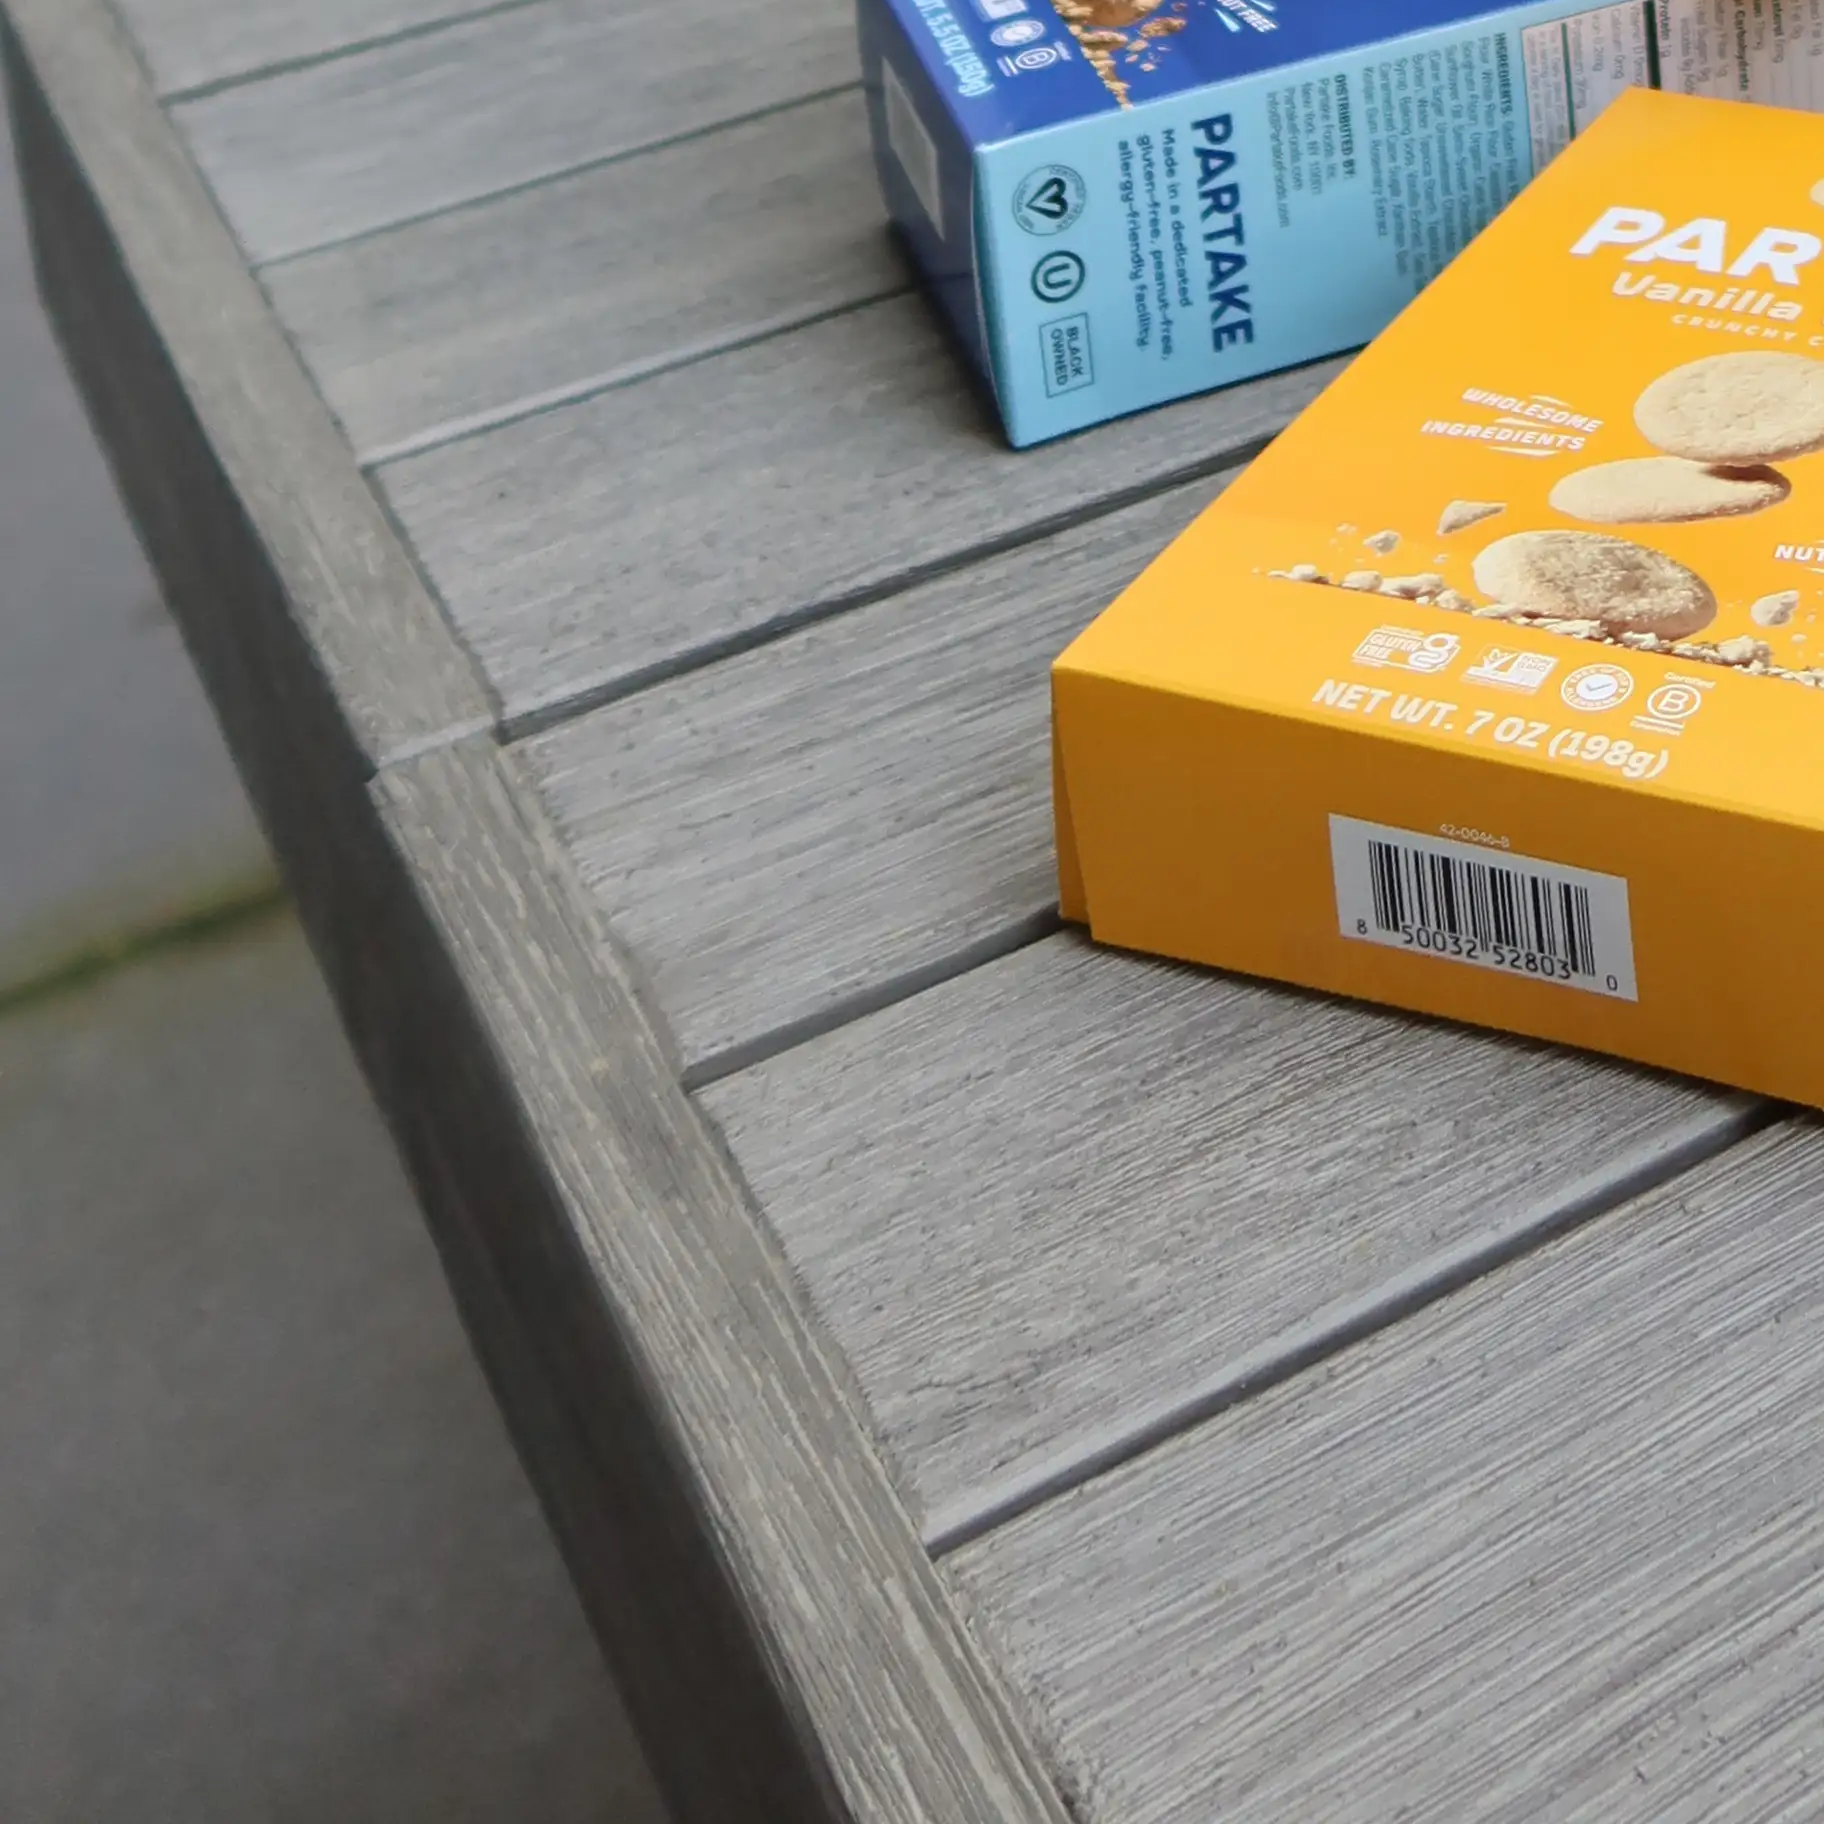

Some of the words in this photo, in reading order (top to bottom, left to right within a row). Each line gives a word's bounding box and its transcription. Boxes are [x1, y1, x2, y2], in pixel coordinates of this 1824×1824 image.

[1334, 74, 1353, 156] DISTRIBUTED
[1161, 128, 1179, 178] Made
[1118, 139, 1147, 282] allergy-friendly
[1165, 181, 1180, 200] in
[1170, 204, 1181, 215] a
[1136, 135, 1162, 250] gluten-free,
[1149, 250, 1175, 361] peanut-free,
[1189, 112, 1255, 354] PARTAKE
[1171, 218, 1195, 308] dedicated
[1610, 271, 1803, 323] Vanilla
[1066, 325, 1084, 378] BLACK
[1670, 314, 1798, 344] CRUNCHY
[1050, 328, 1069, 387] OWNED
[1419, 419, 1587, 452] INGREDIENTS
[1461, 386, 1605, 434] WHOLESOME
[1312, 678, 1393, 714] NET
[1390, 694, 1460, 730] WT.
[1465, 709, 1496, 736] 7
[1491, 714, 1552, 750] OZ
[1547, 727, 1669, 781] (198g)
[1356, 919, 1368, 936] 8
[1400, 924, 1480, 960] 50032
[1492, 943, 1572, 980] 52803
[1605, 975, 1618, 992] 0
